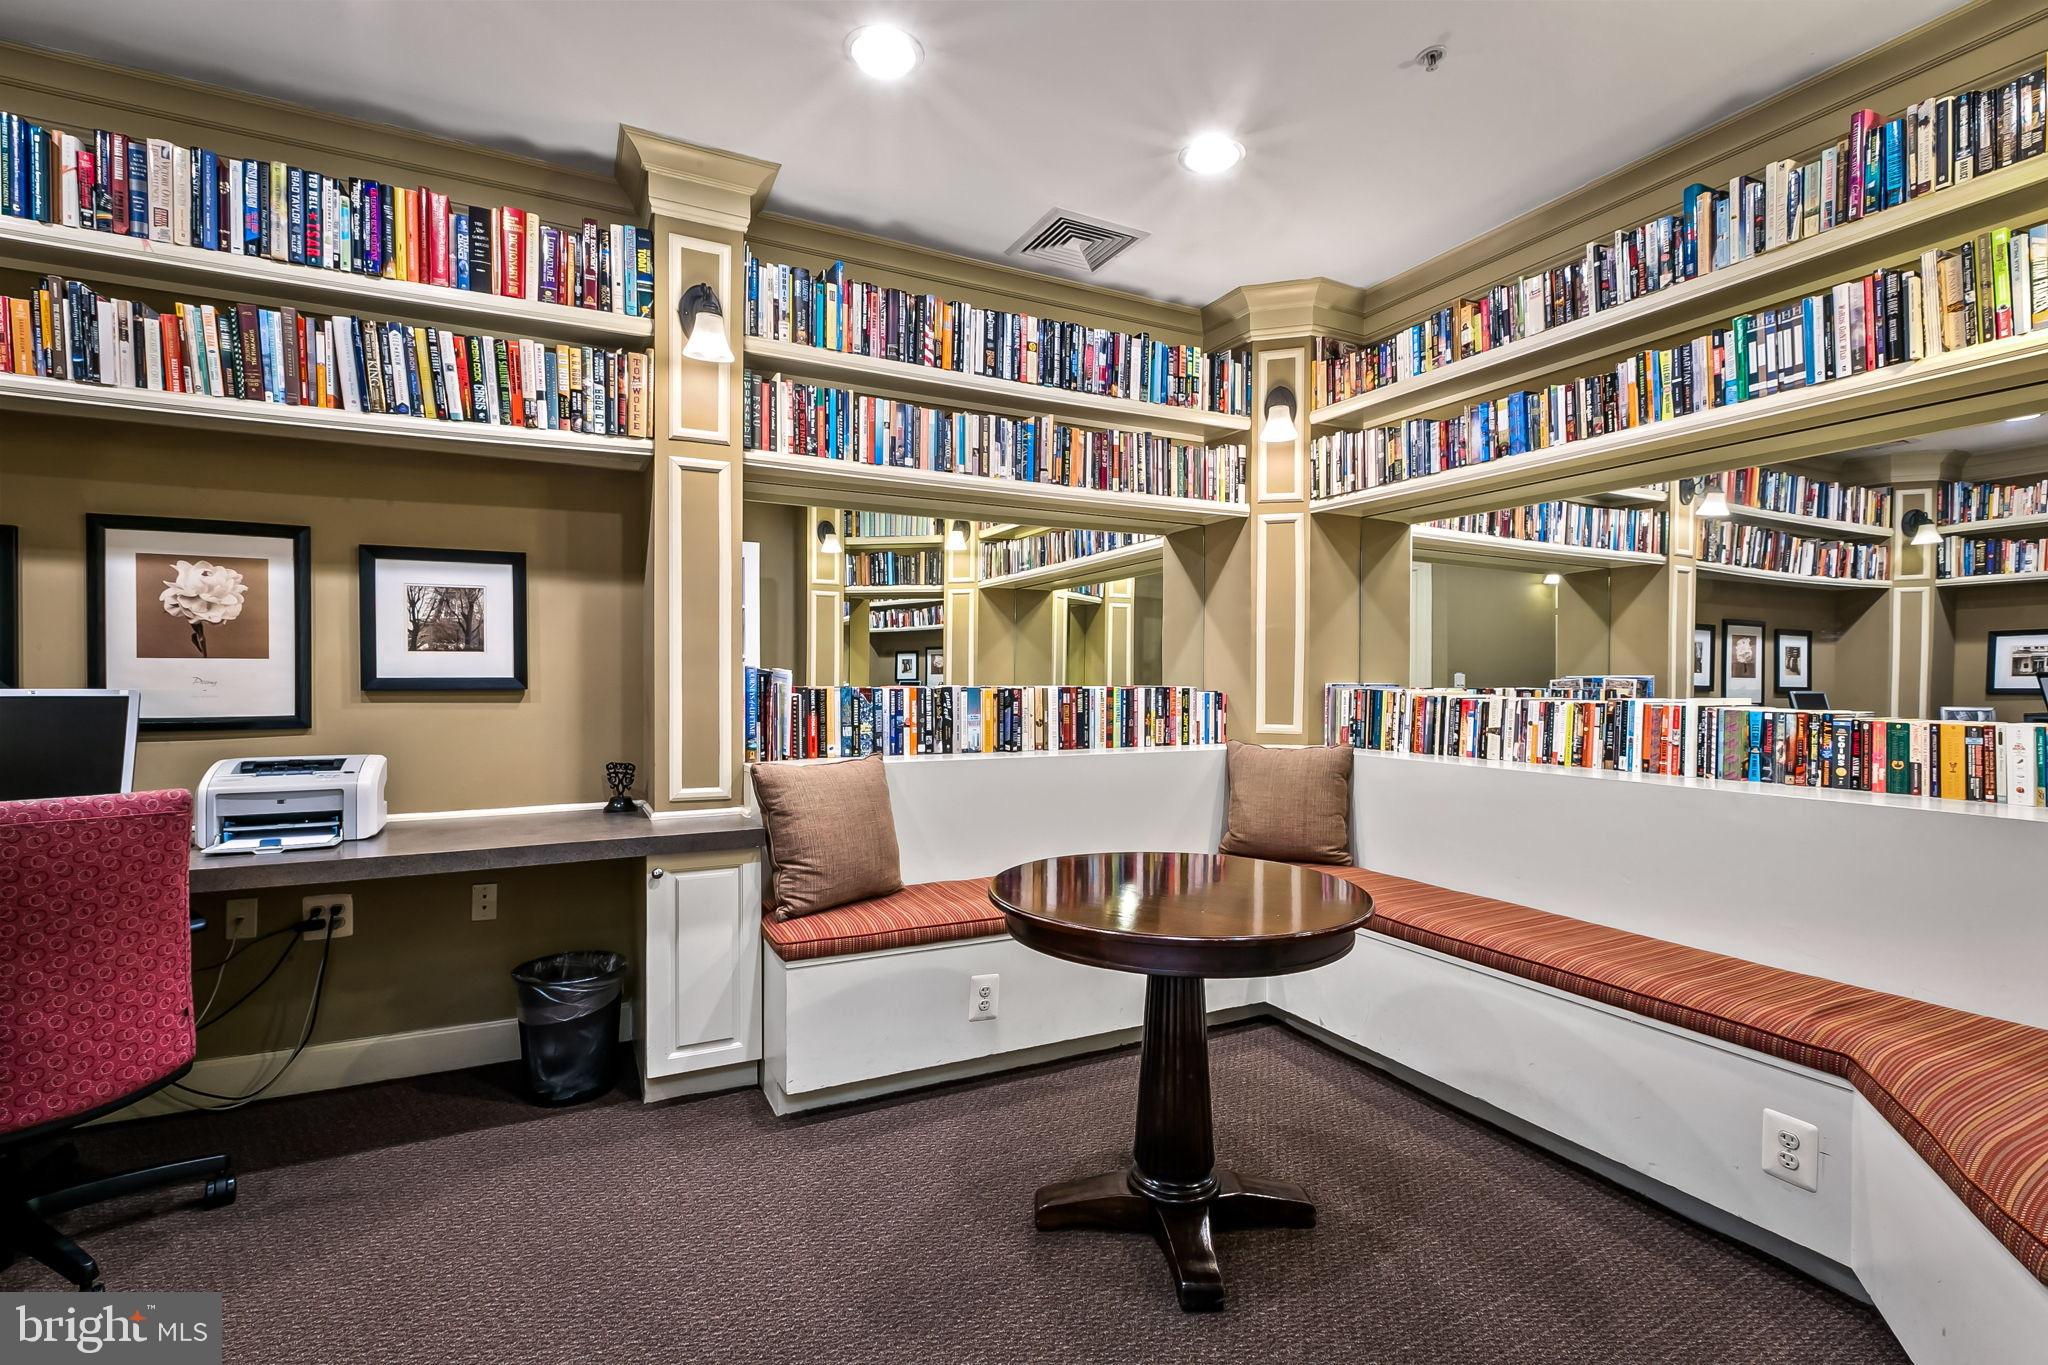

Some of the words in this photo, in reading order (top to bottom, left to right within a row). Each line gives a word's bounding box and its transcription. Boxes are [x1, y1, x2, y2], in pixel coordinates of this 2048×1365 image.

[291, 171, 300, 192] BRAD
[309, 174, 318, 188] TED
[291, 194, 300, 224] TAYLOR
[309, 191, 318, 210] BELL
[307, 223, 320, 257] TSAR
[508, 233, 518, 280] DICTIONARY
[546, 236, 555, 282] LITERATURE
[638, 249, 647, 272] TODAY
[471, 340, 479, 362] ROBIN
[368, 360, 379, 387] KING
[473, 363, 481, 382] COOK
[633, 358, 641, 383] TOM
[474, 384, 486, 410] CRISIS
[633, 387, 641, 430] WOLFE
[1838, 736, 1846, 767] COINS
